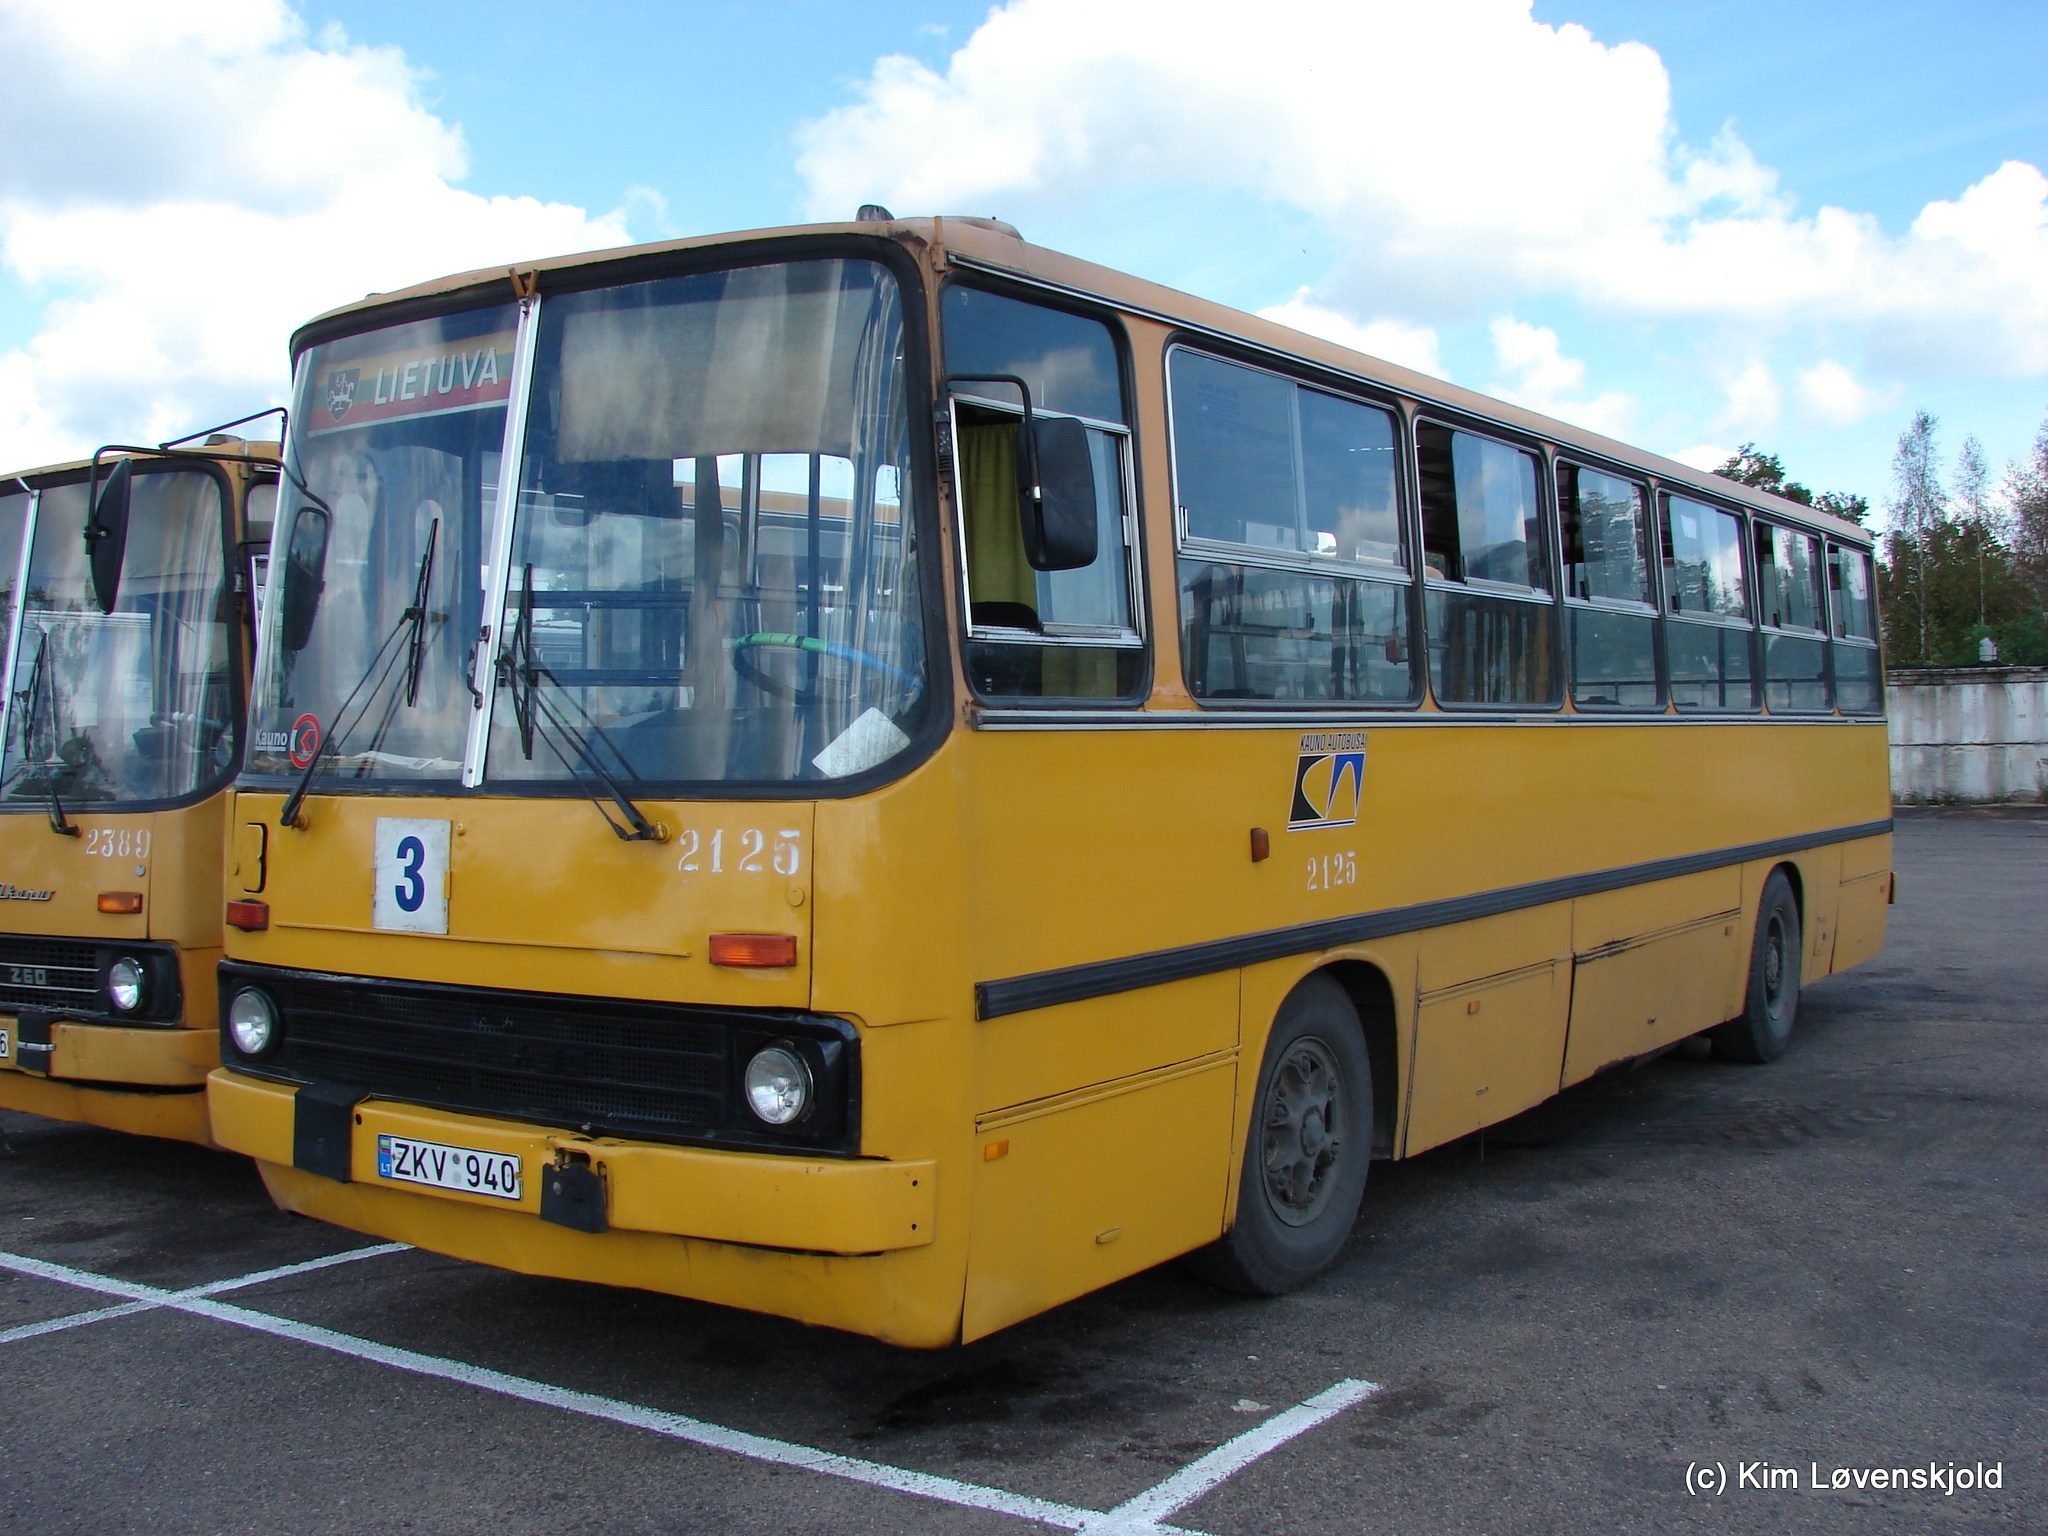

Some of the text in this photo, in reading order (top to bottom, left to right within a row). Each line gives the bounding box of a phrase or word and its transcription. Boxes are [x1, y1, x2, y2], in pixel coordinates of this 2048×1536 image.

[374, 347, 498, 406] LIETUVA
[255, 729, 288, 746] Kauno
[1300, 732, 1367, 751] KAUNO AUTOBUSAI
[86, 829, 151, 858] 2389
[678, 829, 800, 876] 2125
[394, 836, 425, 912] 3
[1307, 852, 1355, 890] 2125
[11, 967, 47, 985] 260
[381, 1162, 391, 1173] LT
[395, 1142, 515, 1193] ZKV 940
